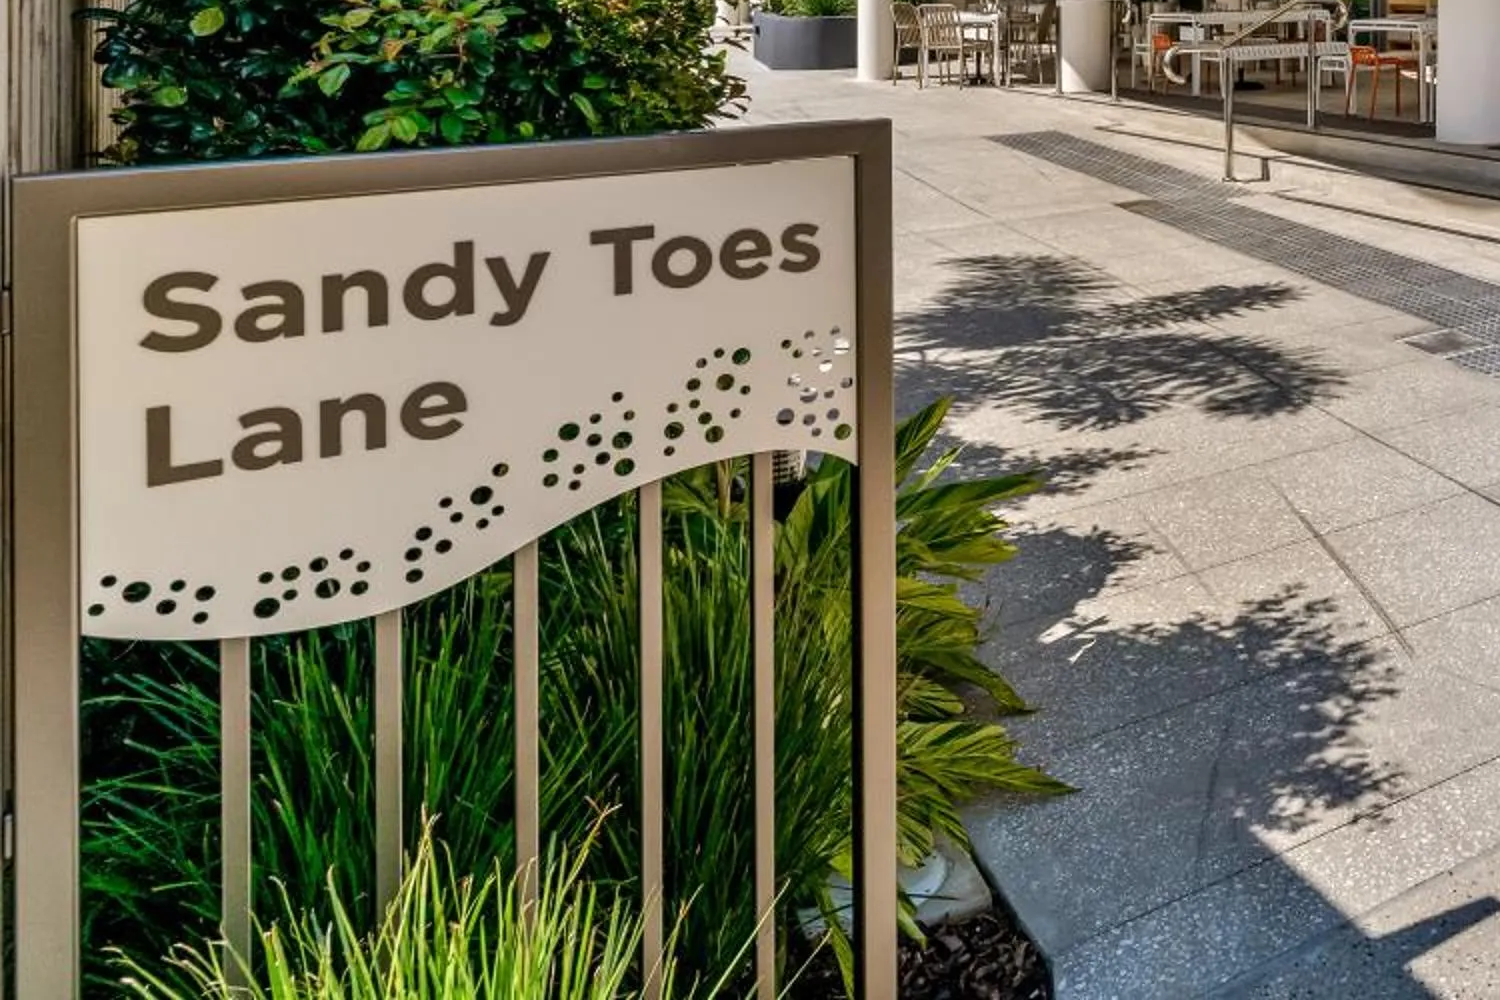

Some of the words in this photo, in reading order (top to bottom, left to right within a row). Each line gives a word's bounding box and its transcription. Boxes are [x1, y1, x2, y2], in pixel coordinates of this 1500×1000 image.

[140, 240, 551, 353] Sandy
[590, 223, 821, 297] Toes
[145, 381, 468, 488] Lane
